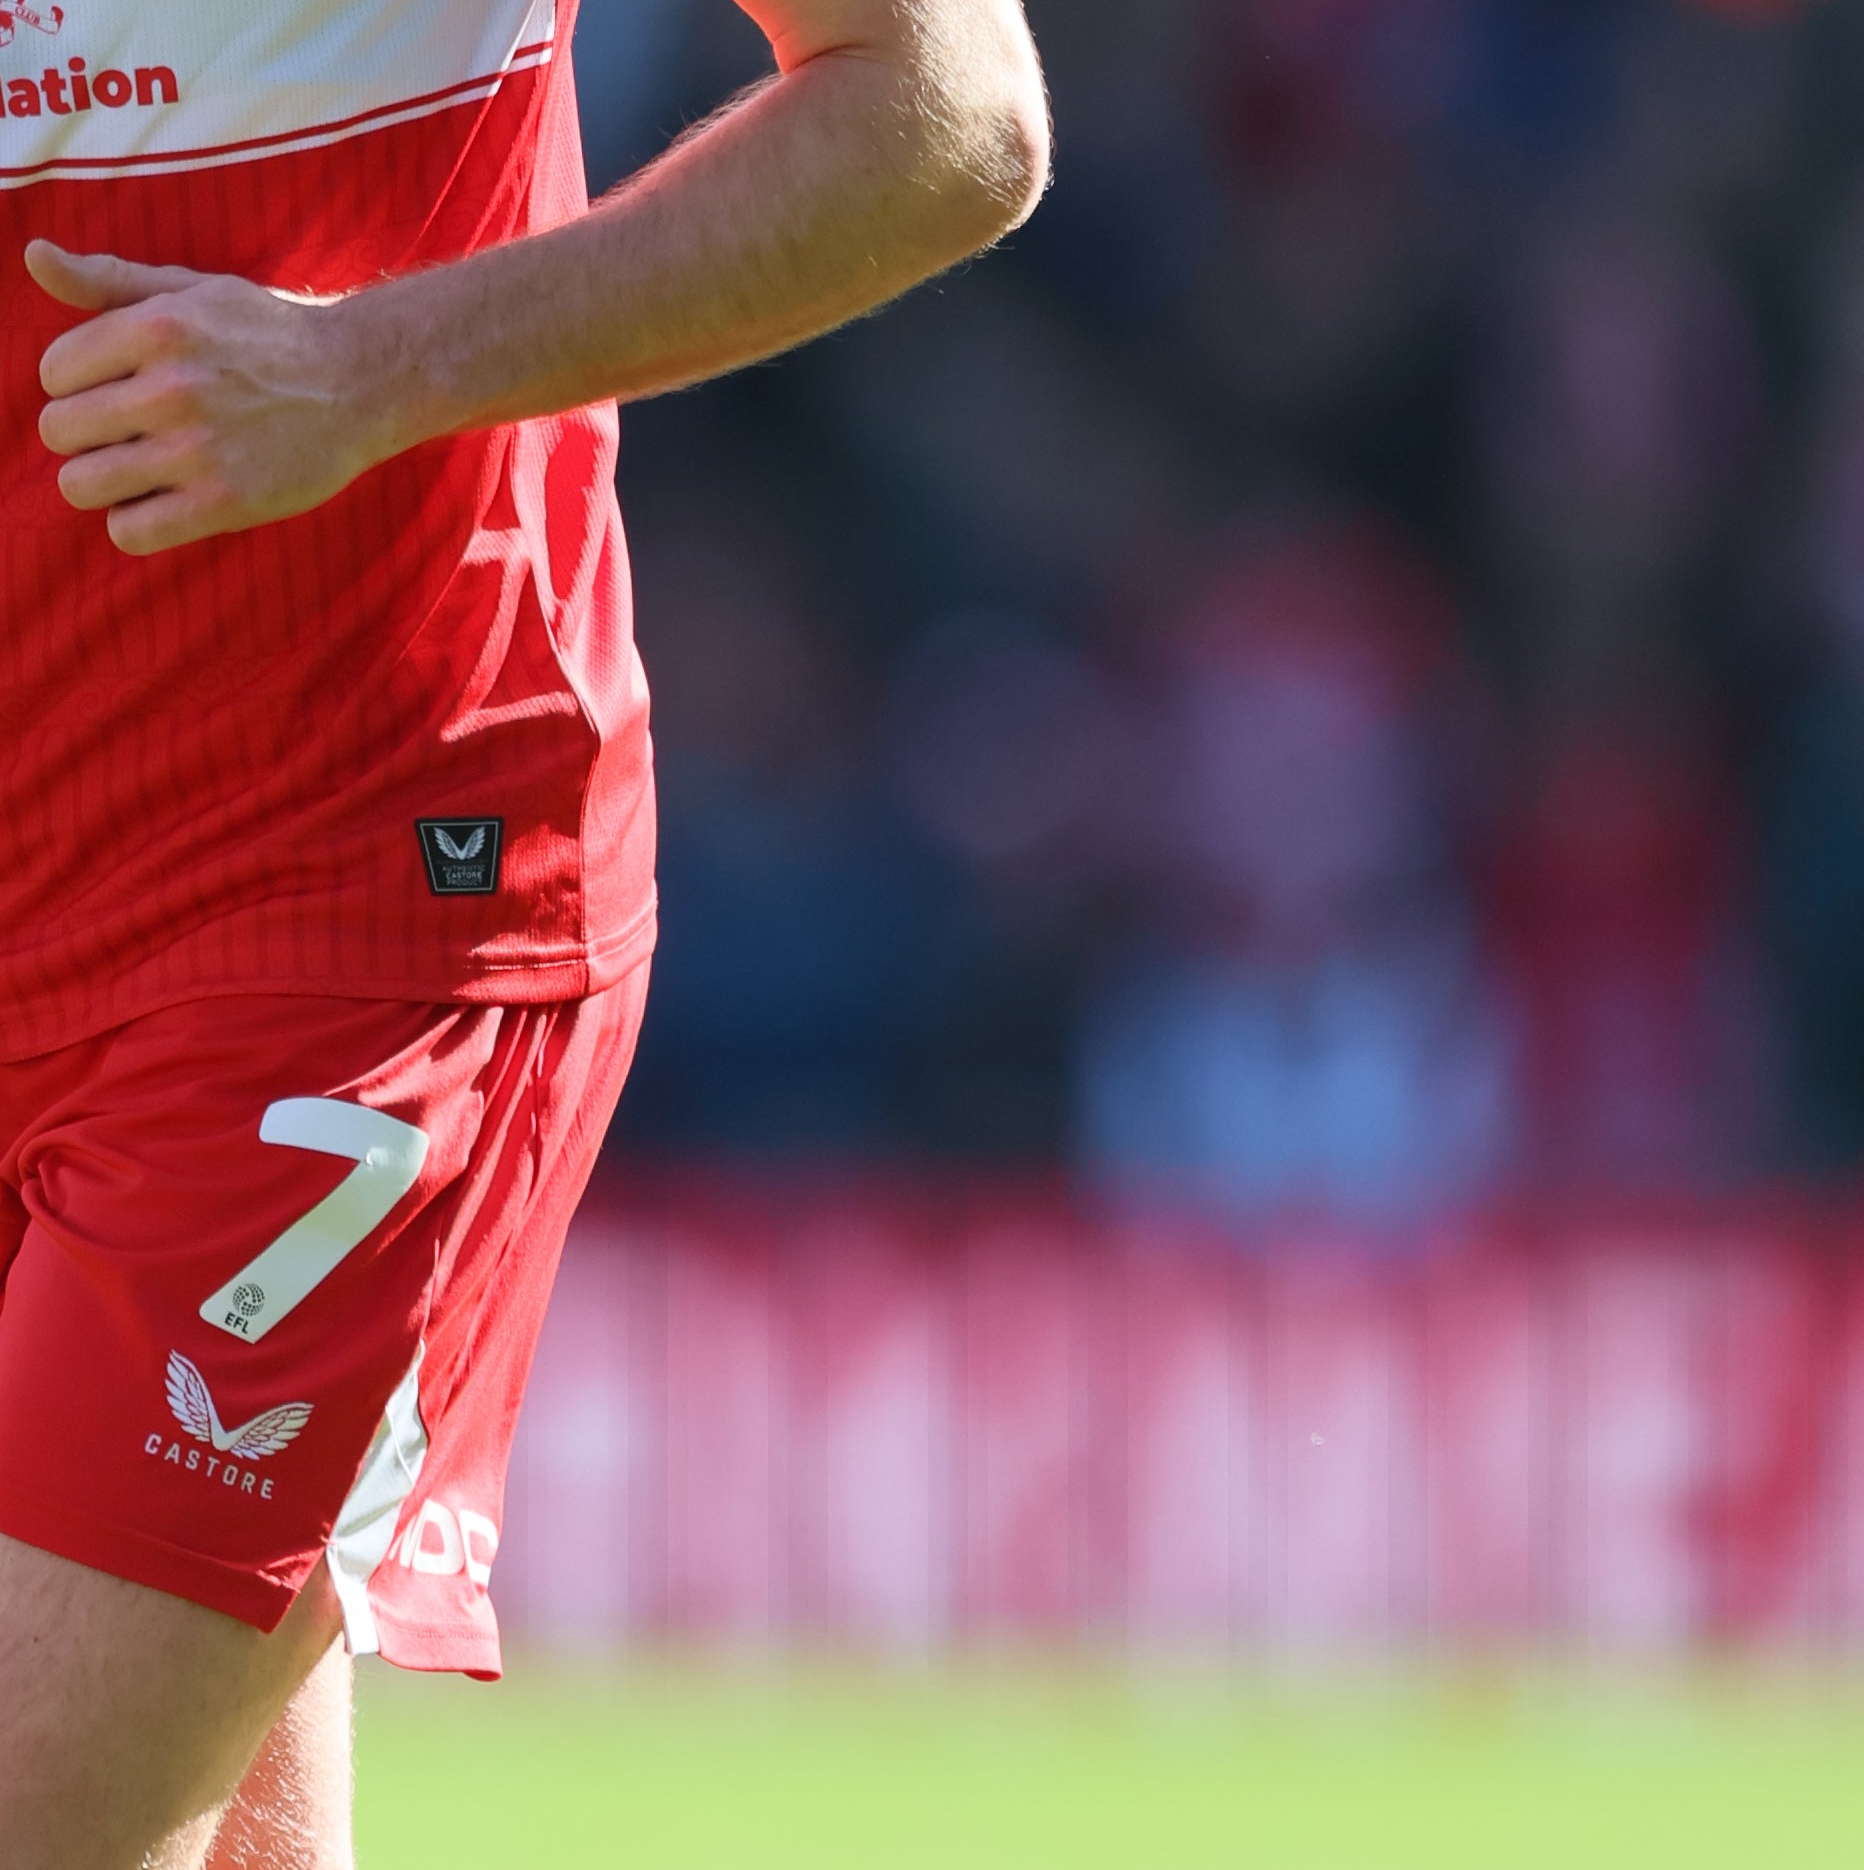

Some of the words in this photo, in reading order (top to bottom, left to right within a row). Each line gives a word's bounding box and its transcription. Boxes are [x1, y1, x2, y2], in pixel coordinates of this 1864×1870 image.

[13, 5, 41, 26] CLUB
[199, 1096, 430, 1345] 7
[224, 1312, 249, 1335] EFL
[144, 1433, 275, 1501] CASTORE
